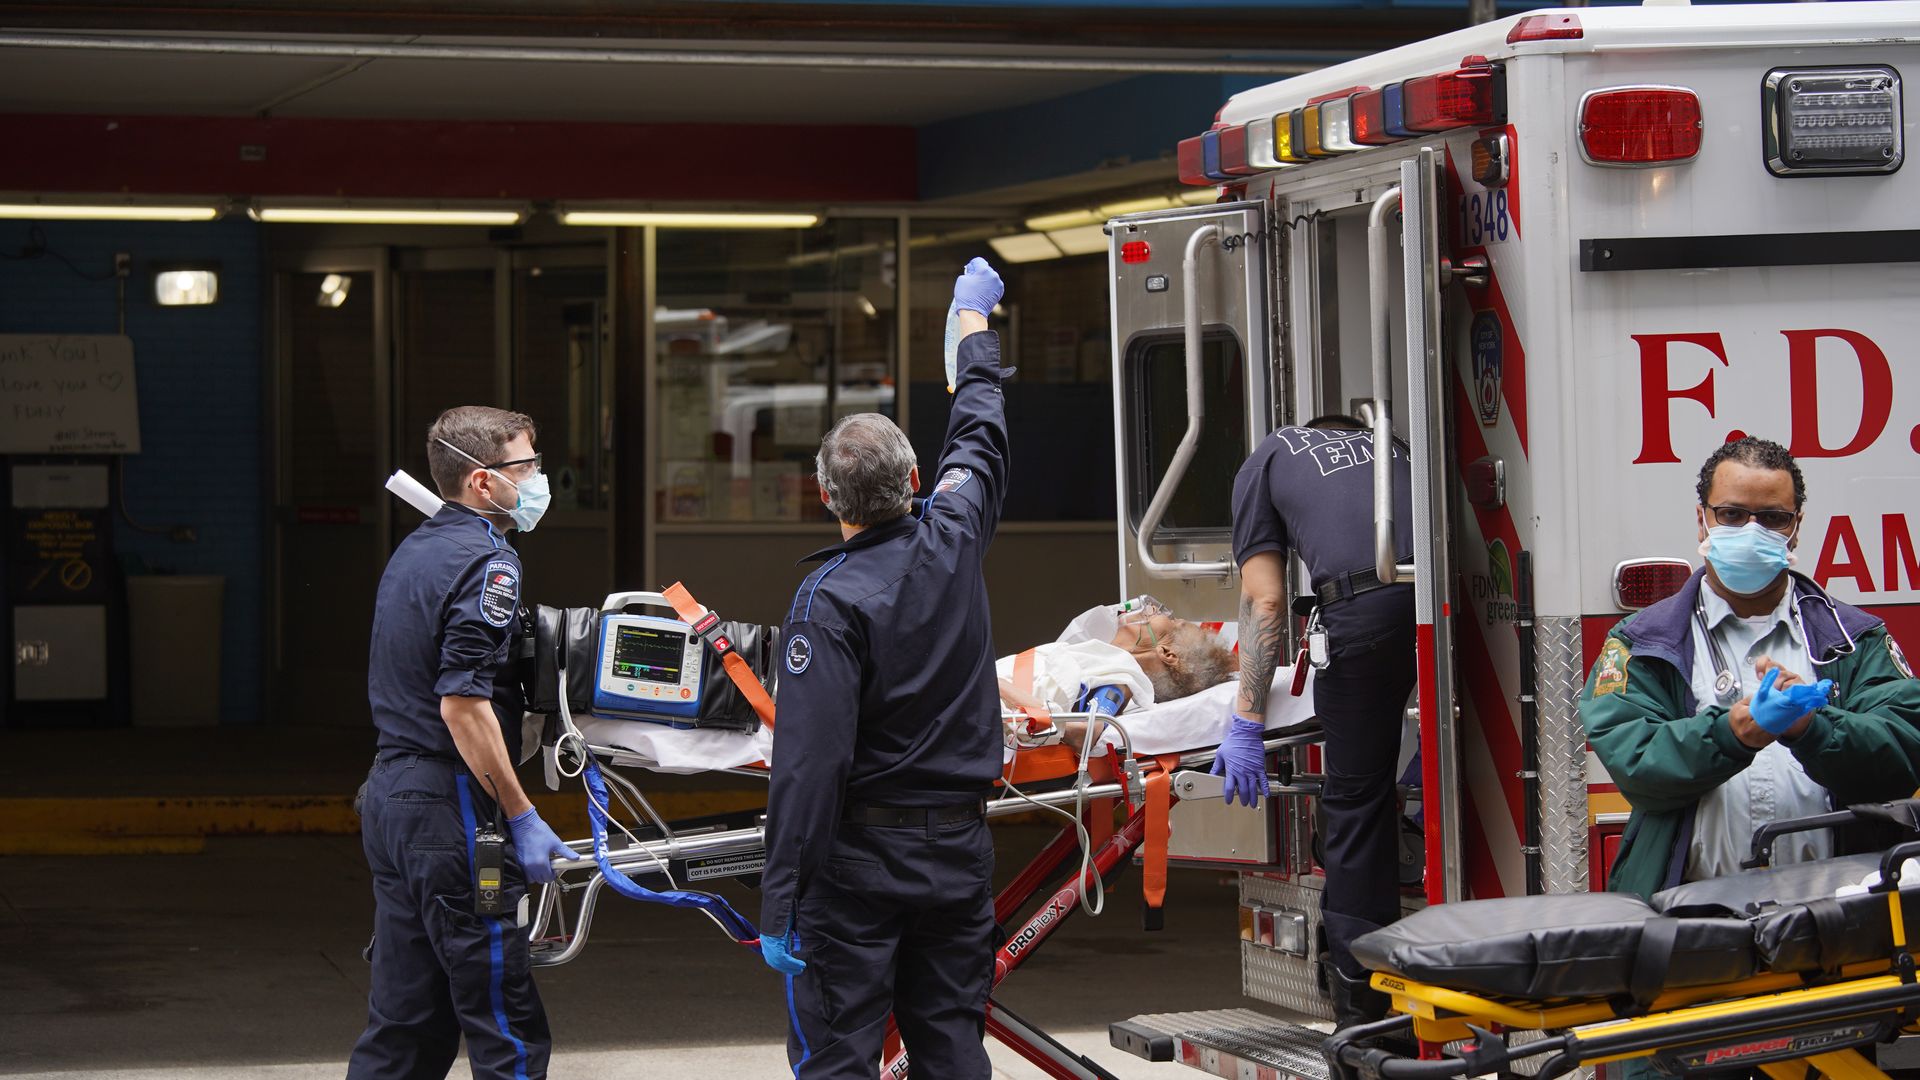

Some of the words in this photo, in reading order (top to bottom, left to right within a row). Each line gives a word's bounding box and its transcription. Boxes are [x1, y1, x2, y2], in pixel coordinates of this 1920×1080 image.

[1460, 189, 1508, 246] 1348
[1472, 575, 1503, 600] FDNY
[1487, 601, 1517, 626] green
